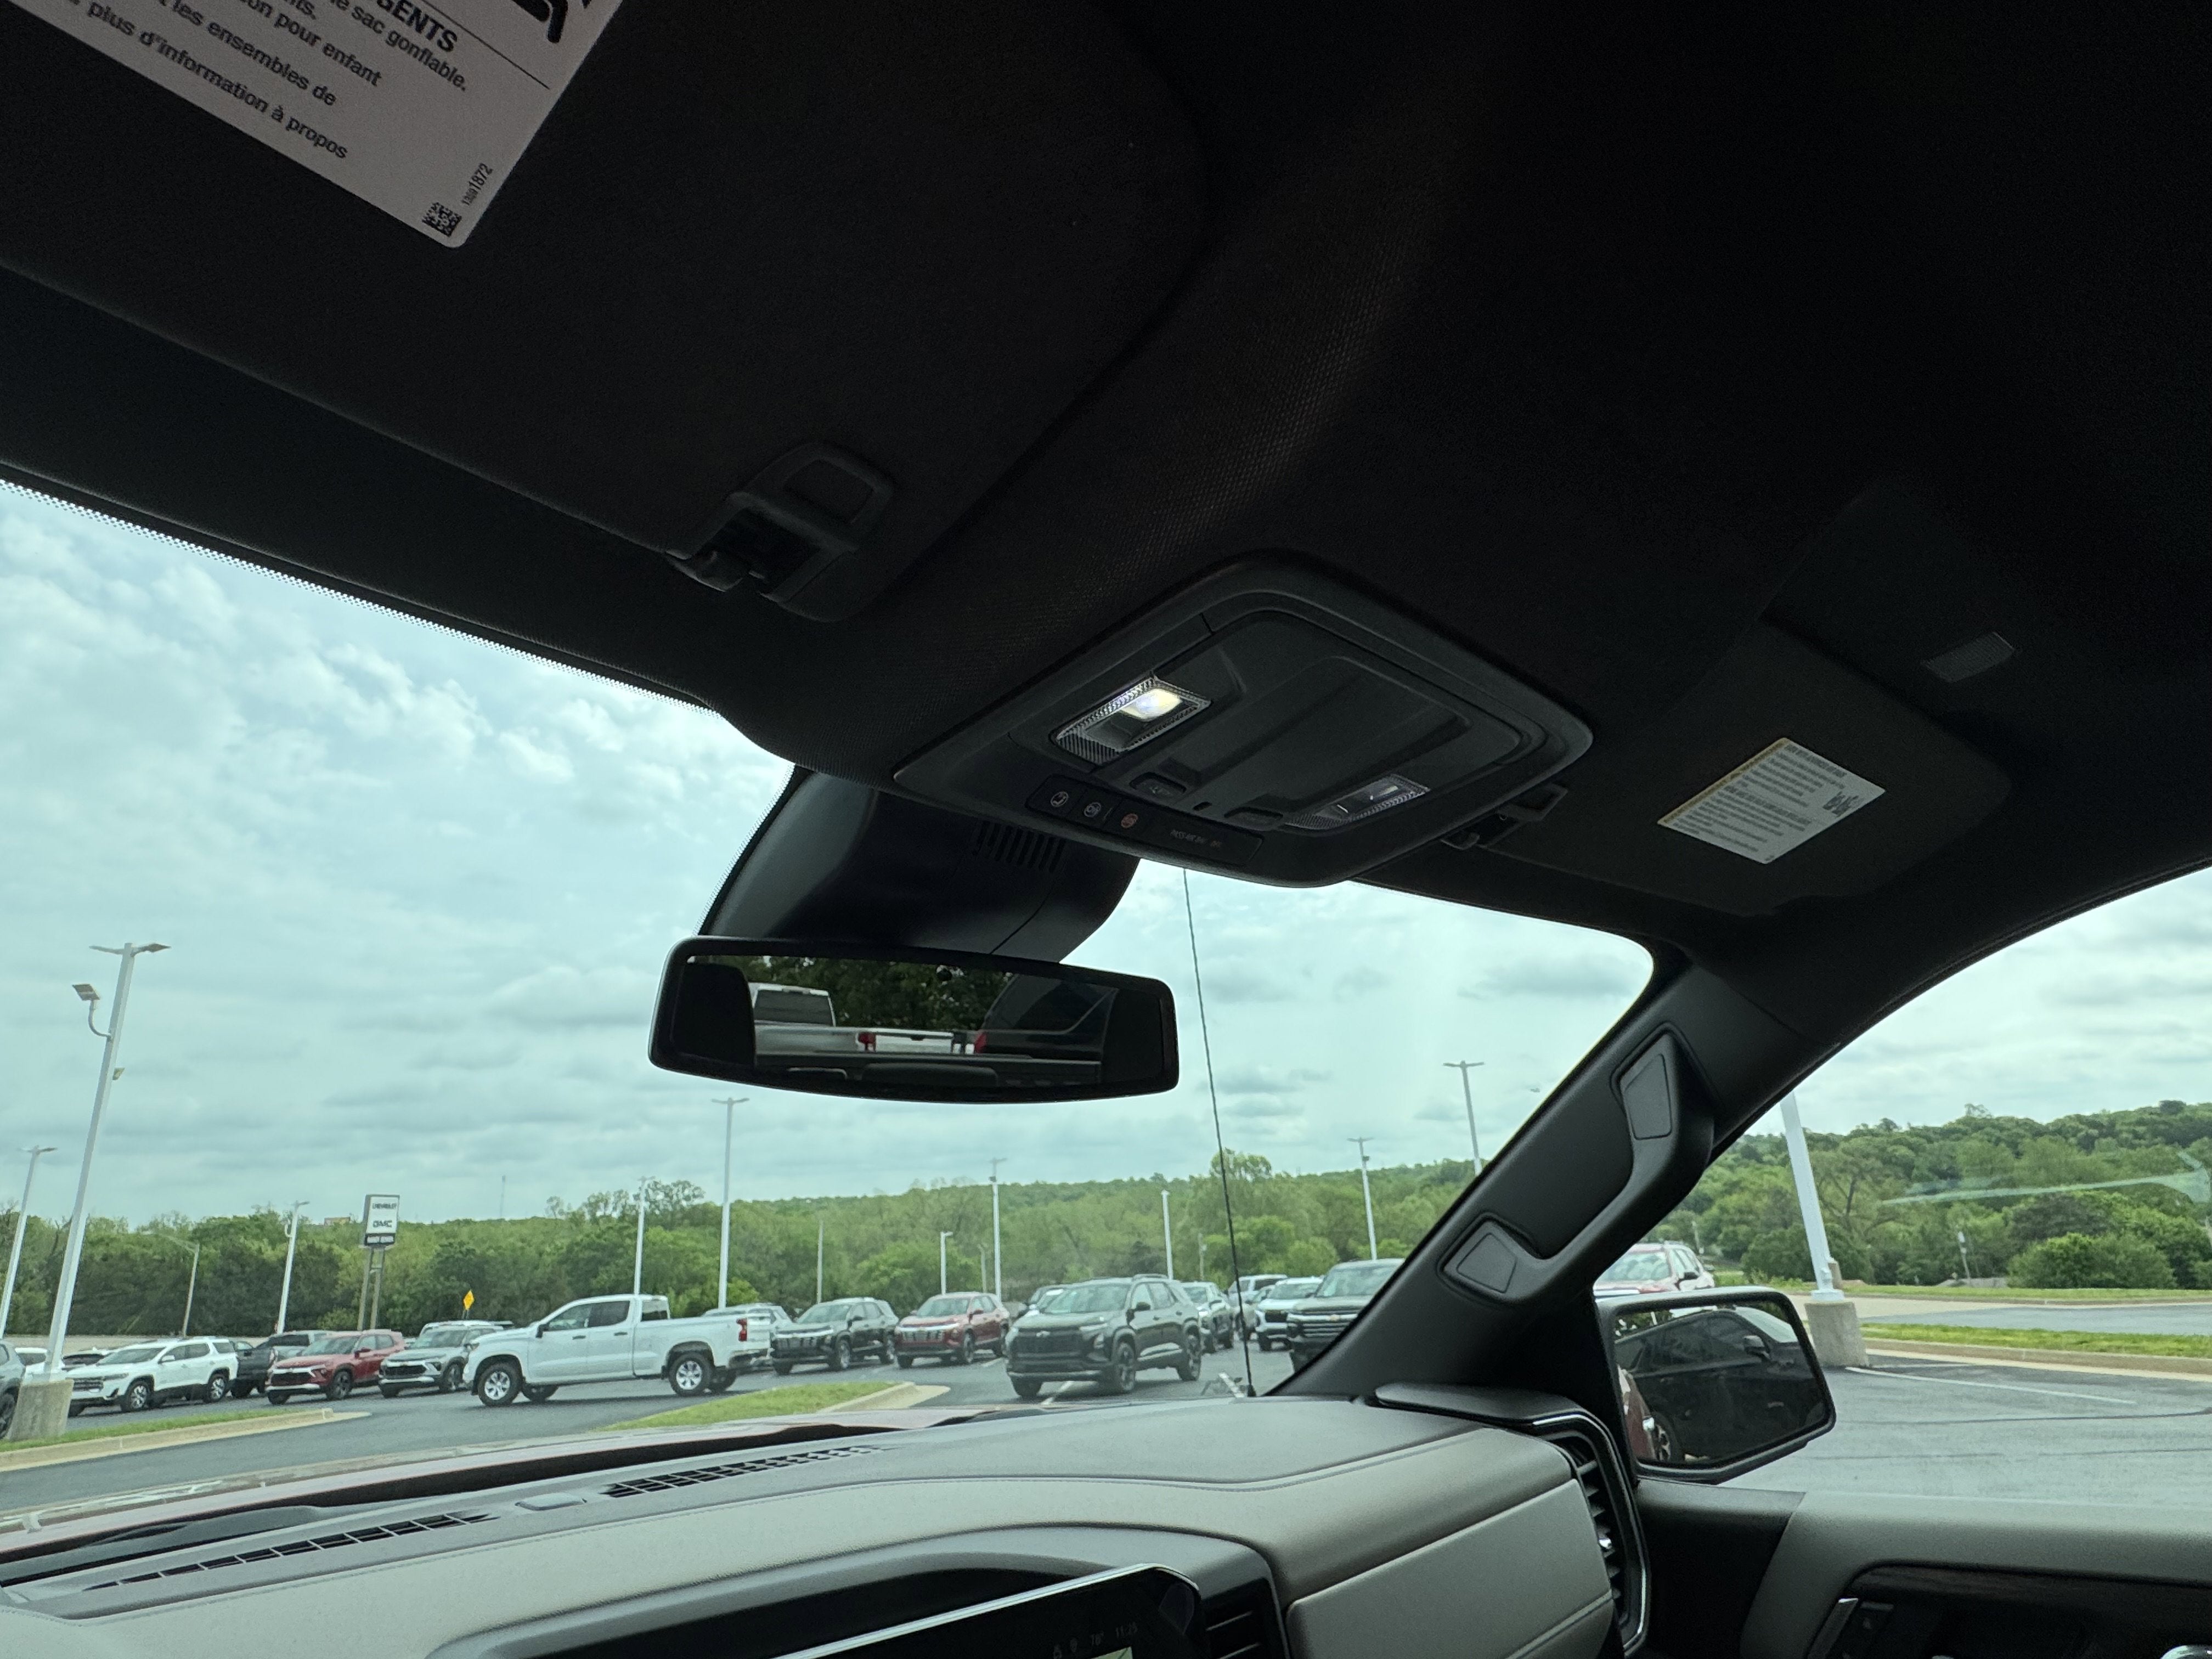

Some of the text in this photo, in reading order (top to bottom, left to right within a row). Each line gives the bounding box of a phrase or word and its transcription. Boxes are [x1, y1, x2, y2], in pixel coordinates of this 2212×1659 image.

[87, 2, 135, 36] plus
[270, 104, 286, 123] à
[285, 116, 348, 160] propos
[172, 0, 337, 106] les ensembles de
[273, 12, 322, 47] pour
[323, 42, 382, 87] enfant
[351, 5, 386, 34] sac
[385, 30, 466, 92] gonflable.
